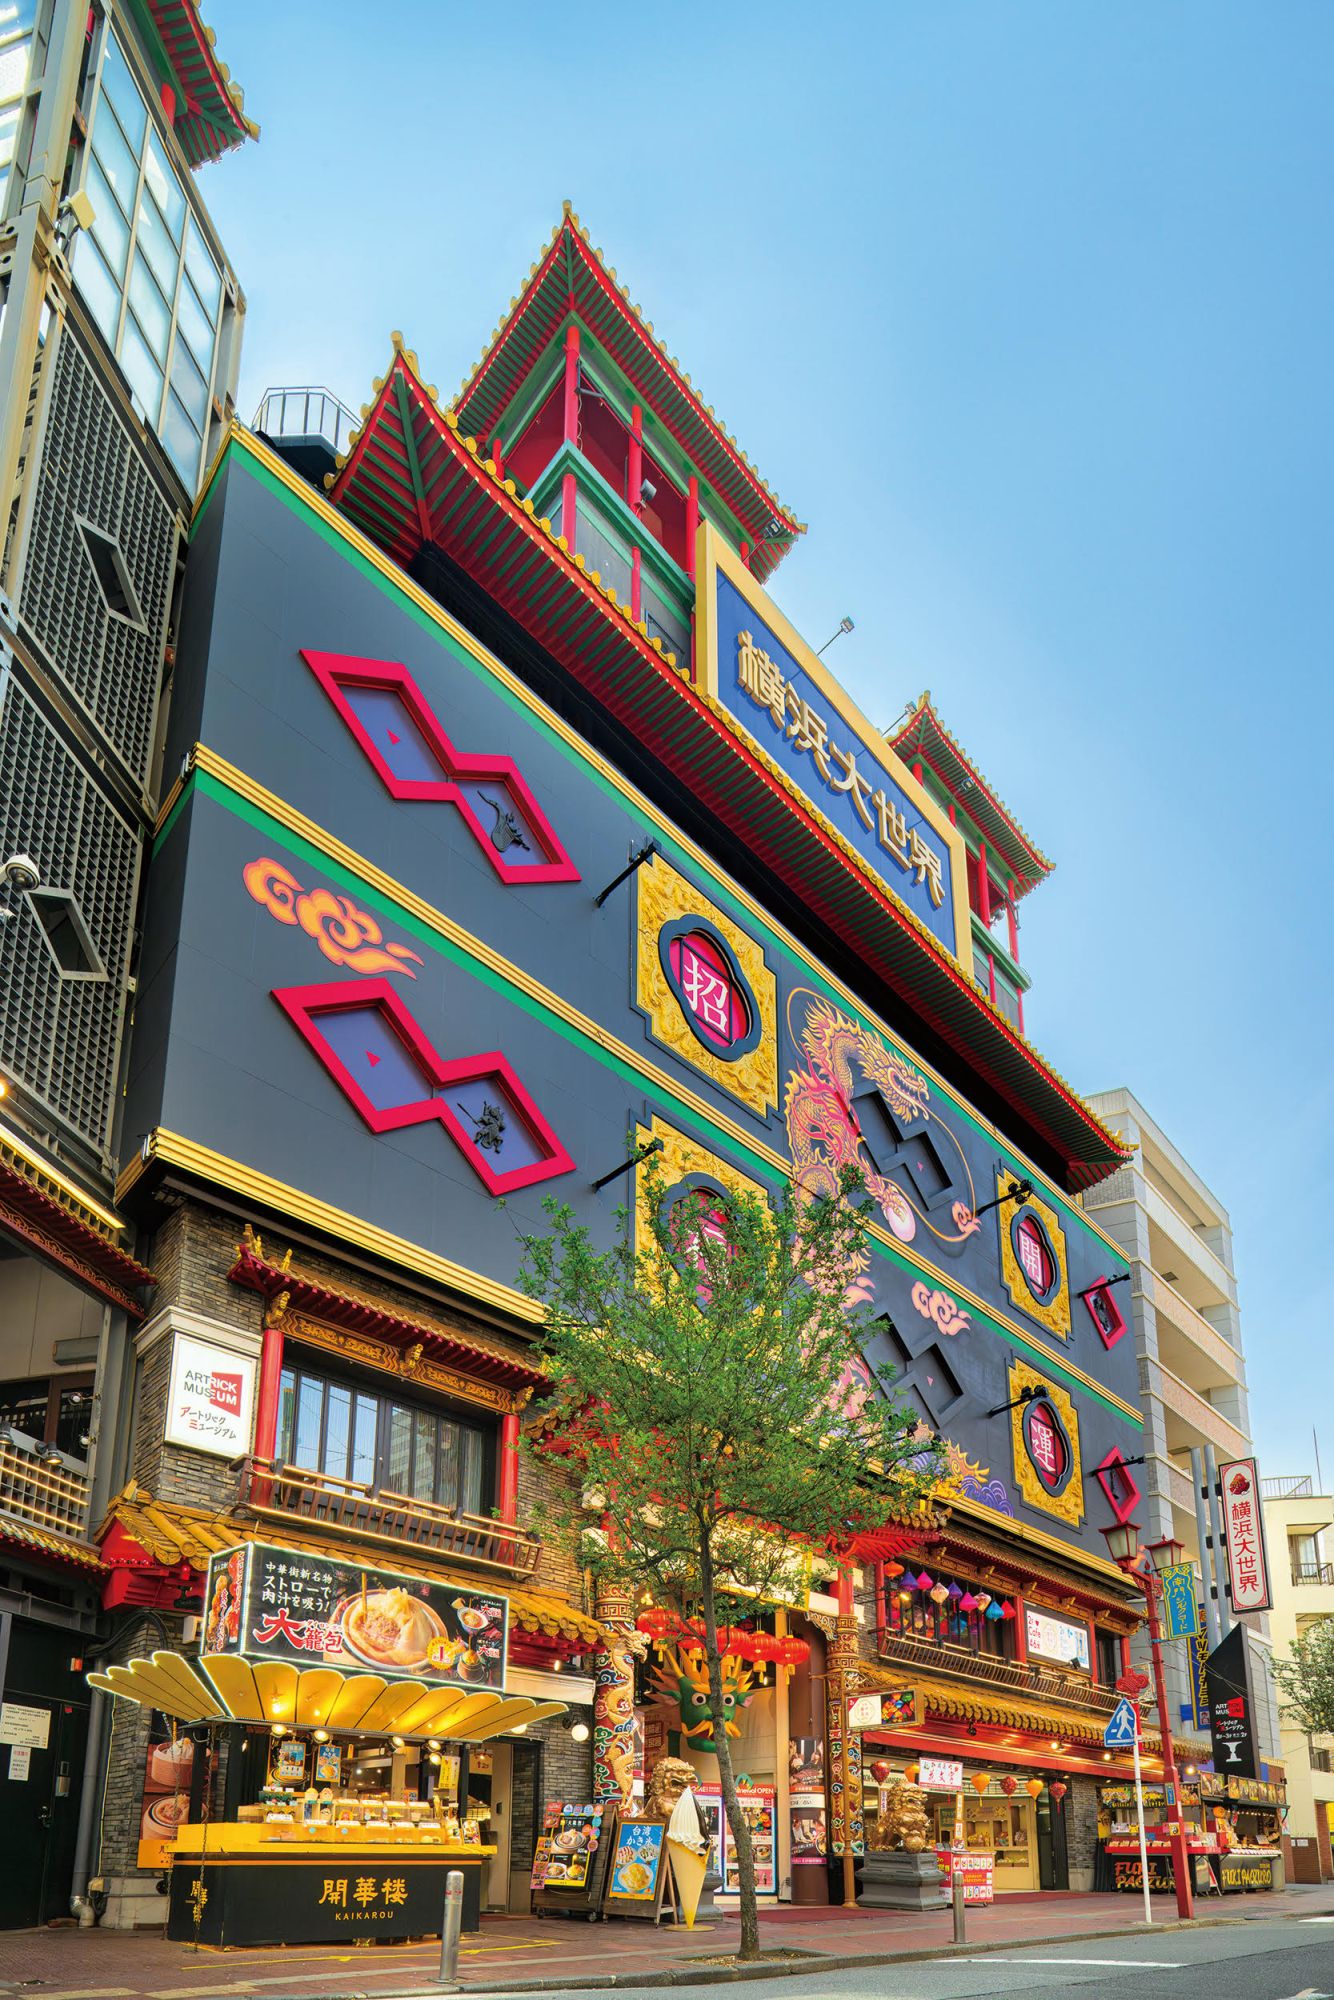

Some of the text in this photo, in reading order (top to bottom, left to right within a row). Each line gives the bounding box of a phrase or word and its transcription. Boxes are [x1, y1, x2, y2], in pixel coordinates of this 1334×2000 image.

[738, 629, 946, 911] 横浜大世界
[683, 952, 728, 1033] 招
[183, 1382, 237, 1406] MUSEUM
[188, 1419, 236, 1440] ミュージアム
[1030, 1419, 1056, 1472] 運
[1231, 1502, 1259, 1594] 横浜大世界
[265, 1562, 333, 1584] 中華街新名物
[263, 1575, 332, 1599] ストローで
[632, 1825, 652, 1836] 台湾
[318, 1877, 409, 1908] 開華楼
[335, 1911, 394, 1921] KAIKAROU
